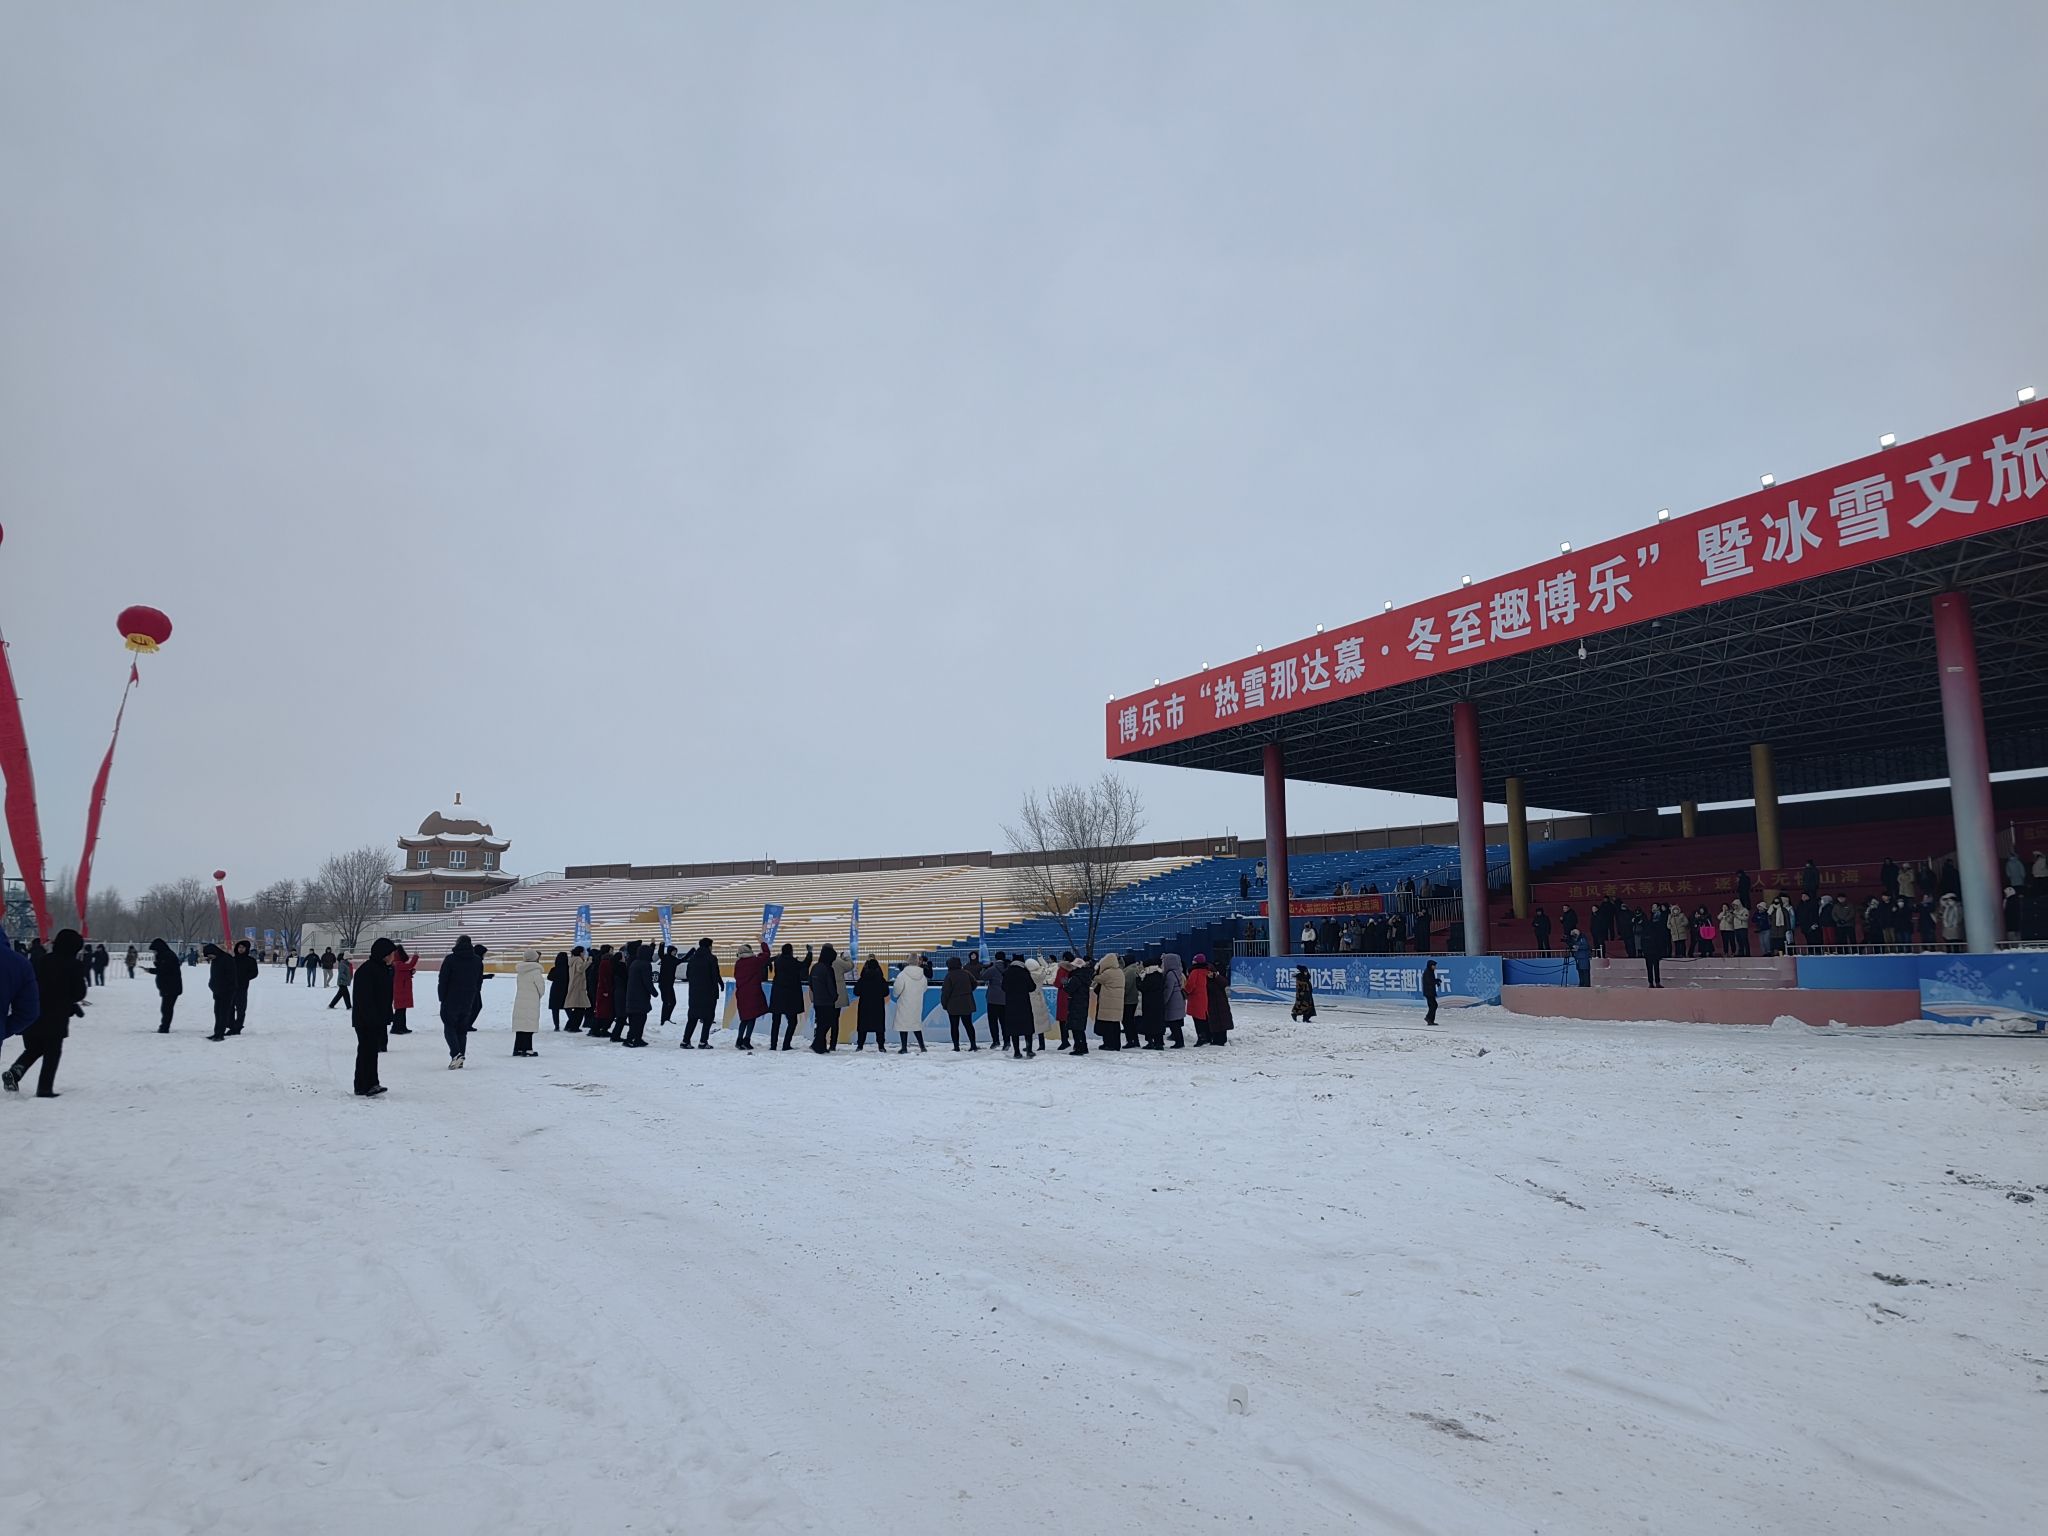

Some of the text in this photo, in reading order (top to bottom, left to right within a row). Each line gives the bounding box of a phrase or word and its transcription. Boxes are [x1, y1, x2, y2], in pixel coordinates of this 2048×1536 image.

[1568, 869, 1861, 898] 追风者不等风来，逐人无山海
